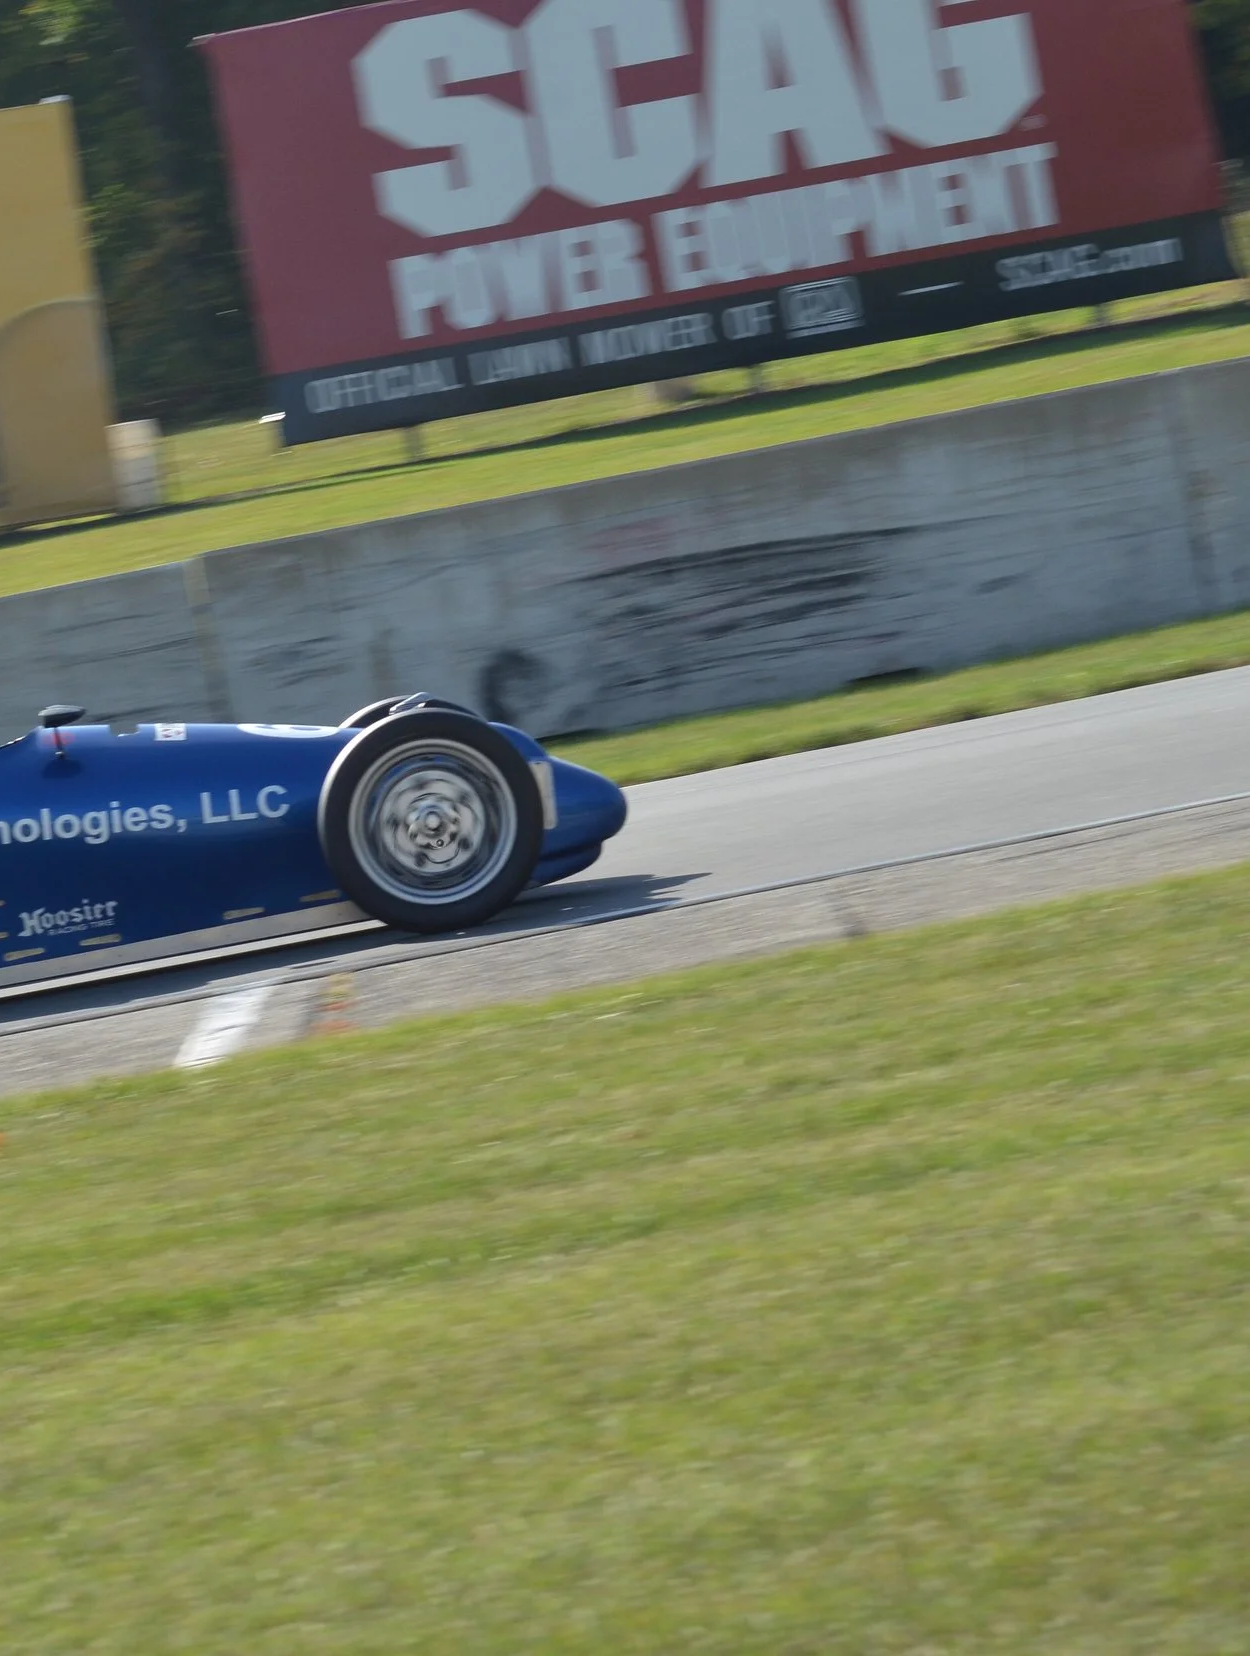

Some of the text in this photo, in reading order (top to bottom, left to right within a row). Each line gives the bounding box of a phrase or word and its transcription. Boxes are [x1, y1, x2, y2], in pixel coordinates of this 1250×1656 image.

[351, 0, 1046, 238] SCAG
[386, 218, 652, 340] POWER
[650, 142, 1059, 292] EQUIPMENT
[304, 357, 467, 413] OFFICIAL
[467, 337, 575, 386] LAWN
[576, 313, 718, 367] MOWER
[721, 301, 776, 340] OF
[200, 784, 291, 824] LLC
[17, 898, 118, 937] Hoosier
